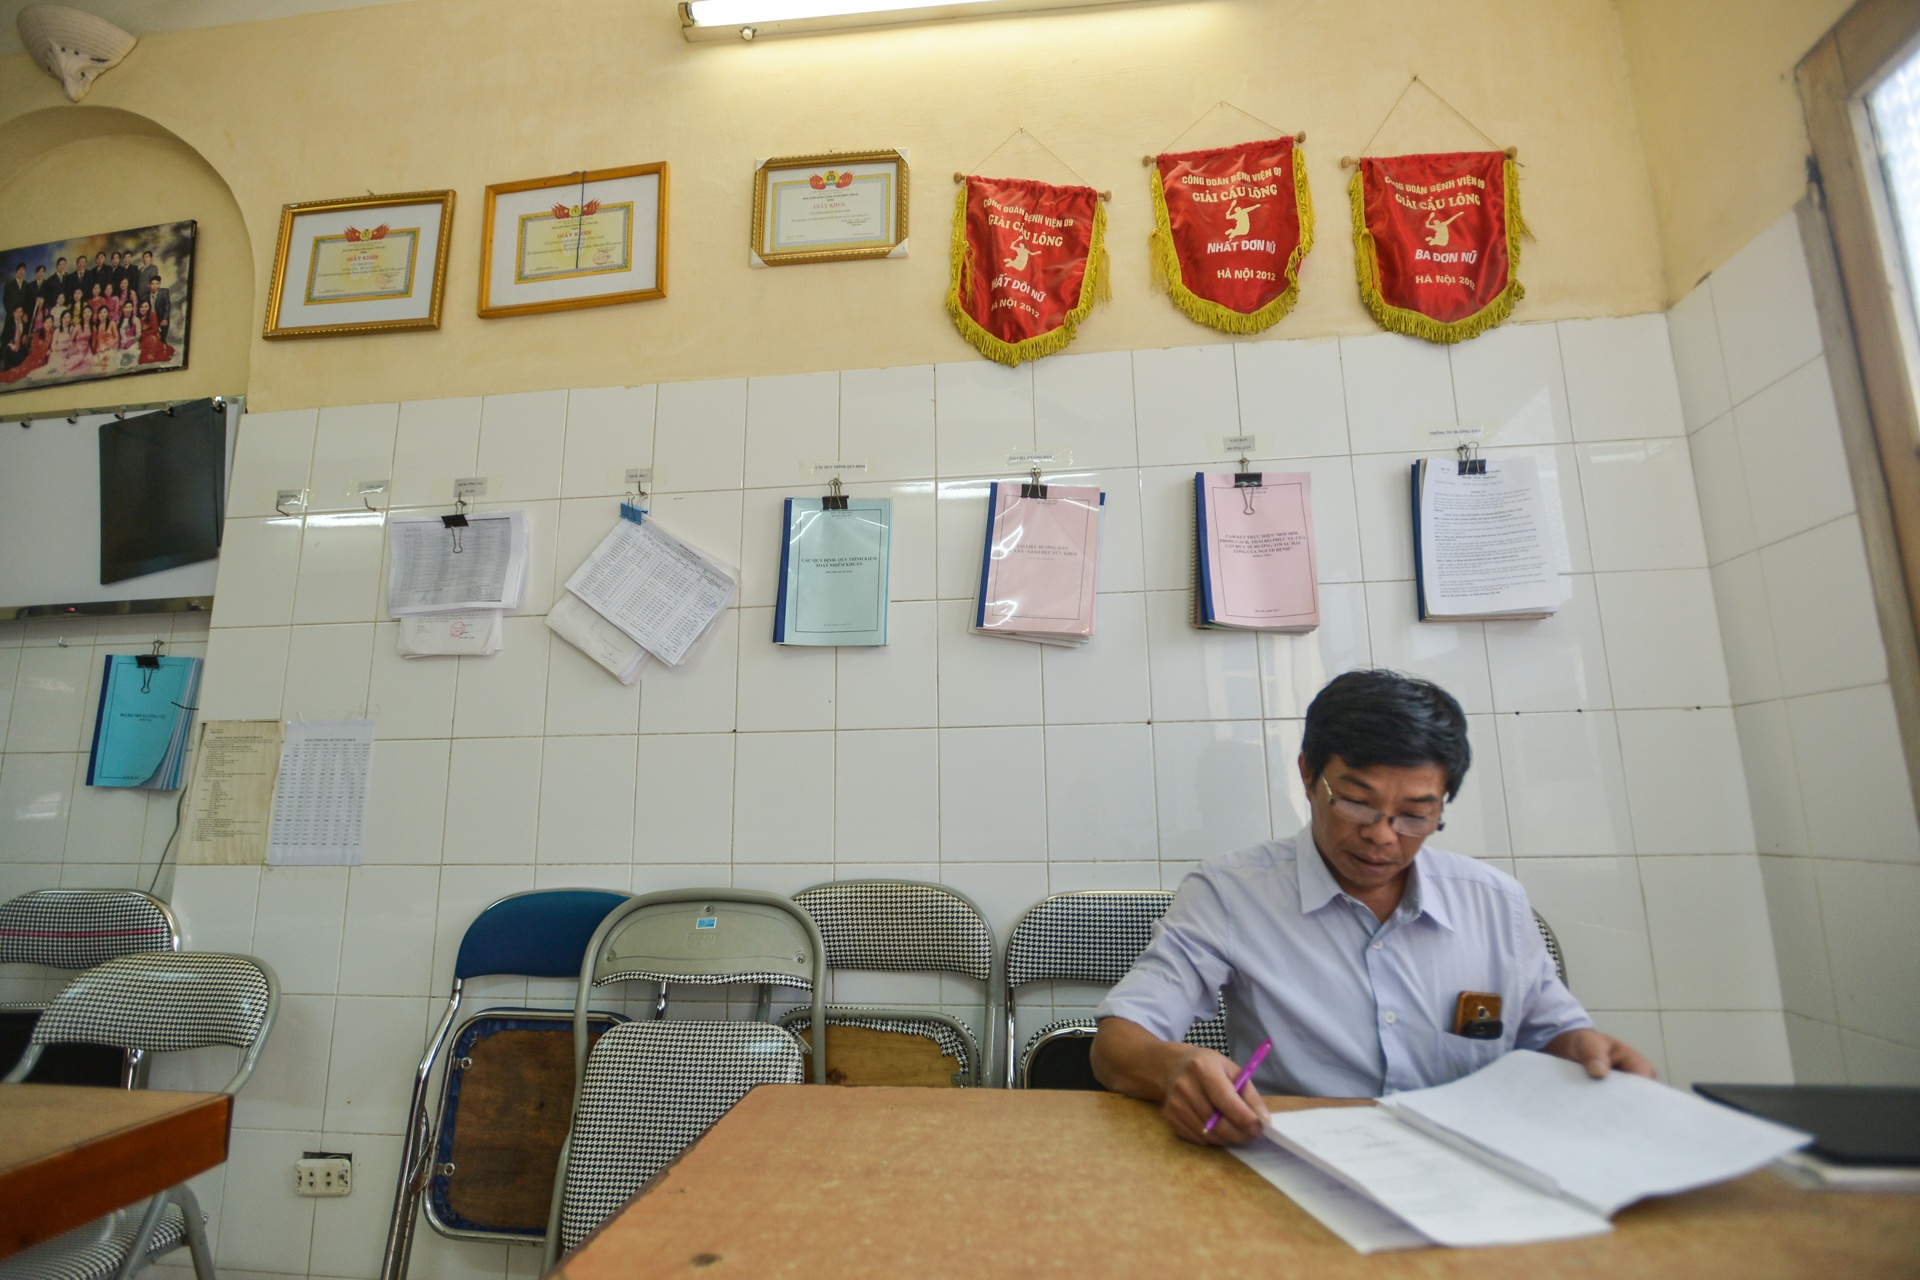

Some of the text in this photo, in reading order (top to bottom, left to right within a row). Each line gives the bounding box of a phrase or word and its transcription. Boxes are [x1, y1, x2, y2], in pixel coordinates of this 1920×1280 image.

[1182, 173, 1204, 186] CÔNG
[1192, 189, 1219, 203] GIẢI
[1247, 184, 1277, 199] LÔNG
[1395, 192, 1481, 211] GIẢI CẦU LÔNG
[988, 213, 1011, 229] GIẢI
[1032, 231, 1064, 247] LÔNG
[1044, 216, 1063, 229] VIỆN
[1063, 218, 1074, 228] 09
[1207, 239, 1239, 254] NHẤT
[1241, 239, 1265, 251] ĐƠN
[1415, 249, 1478, 265] BA ĐƠN NỮ
[1217, 267, 1276, 282] HÀ NỘI 2012
[1415, 273, 1433, 284] HÀ
[1435, 274, 1456, 286] NỘI
[1011, 279, 1031, 294] ĐÔI
[1030, 288, 1047, 303] NỮ
[999, 296, 1018, 310] NỘI
[1018, 302, 1040, 319] 2012
